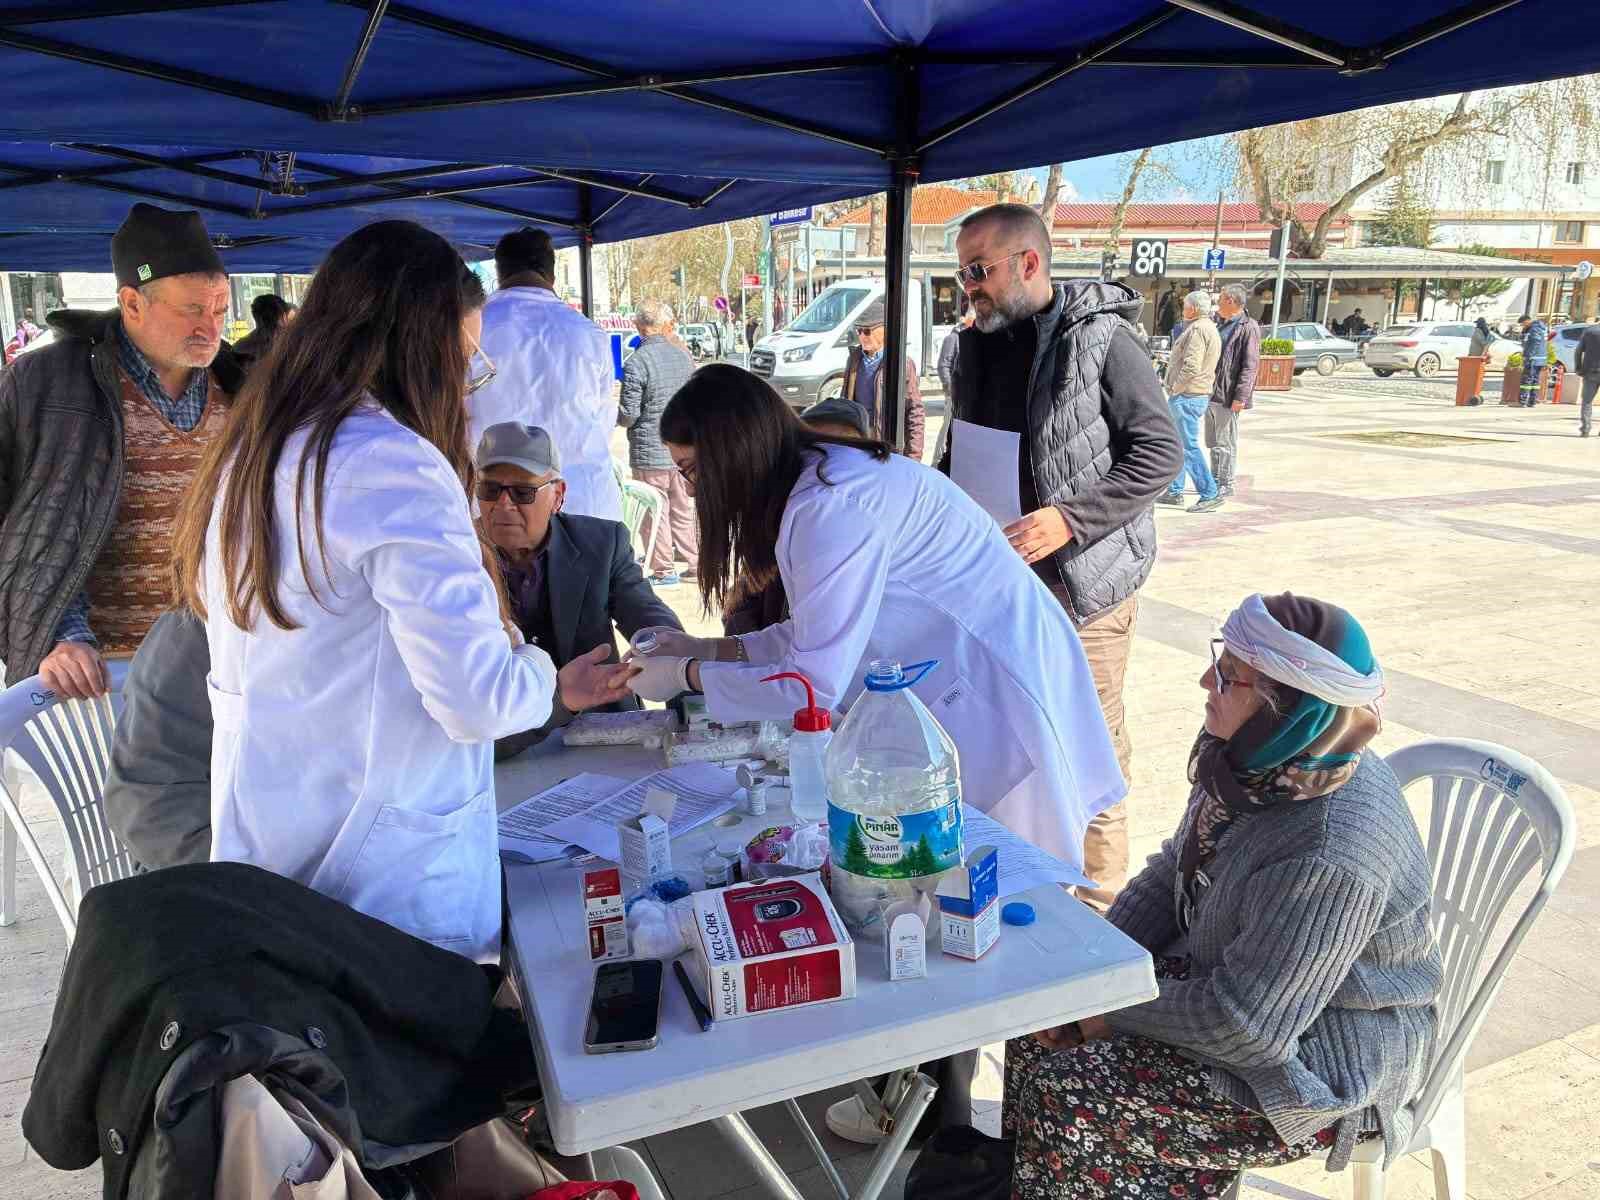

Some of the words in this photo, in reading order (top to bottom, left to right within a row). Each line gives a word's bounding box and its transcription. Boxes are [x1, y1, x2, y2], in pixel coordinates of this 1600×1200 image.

[1137, 241, 1164, 258] on
[1135, 257, 1163, 274] on
[705, 912, 728, 962] ACCU-CHEK
[722, 970, 733, 1016] ACCU-CHEK
